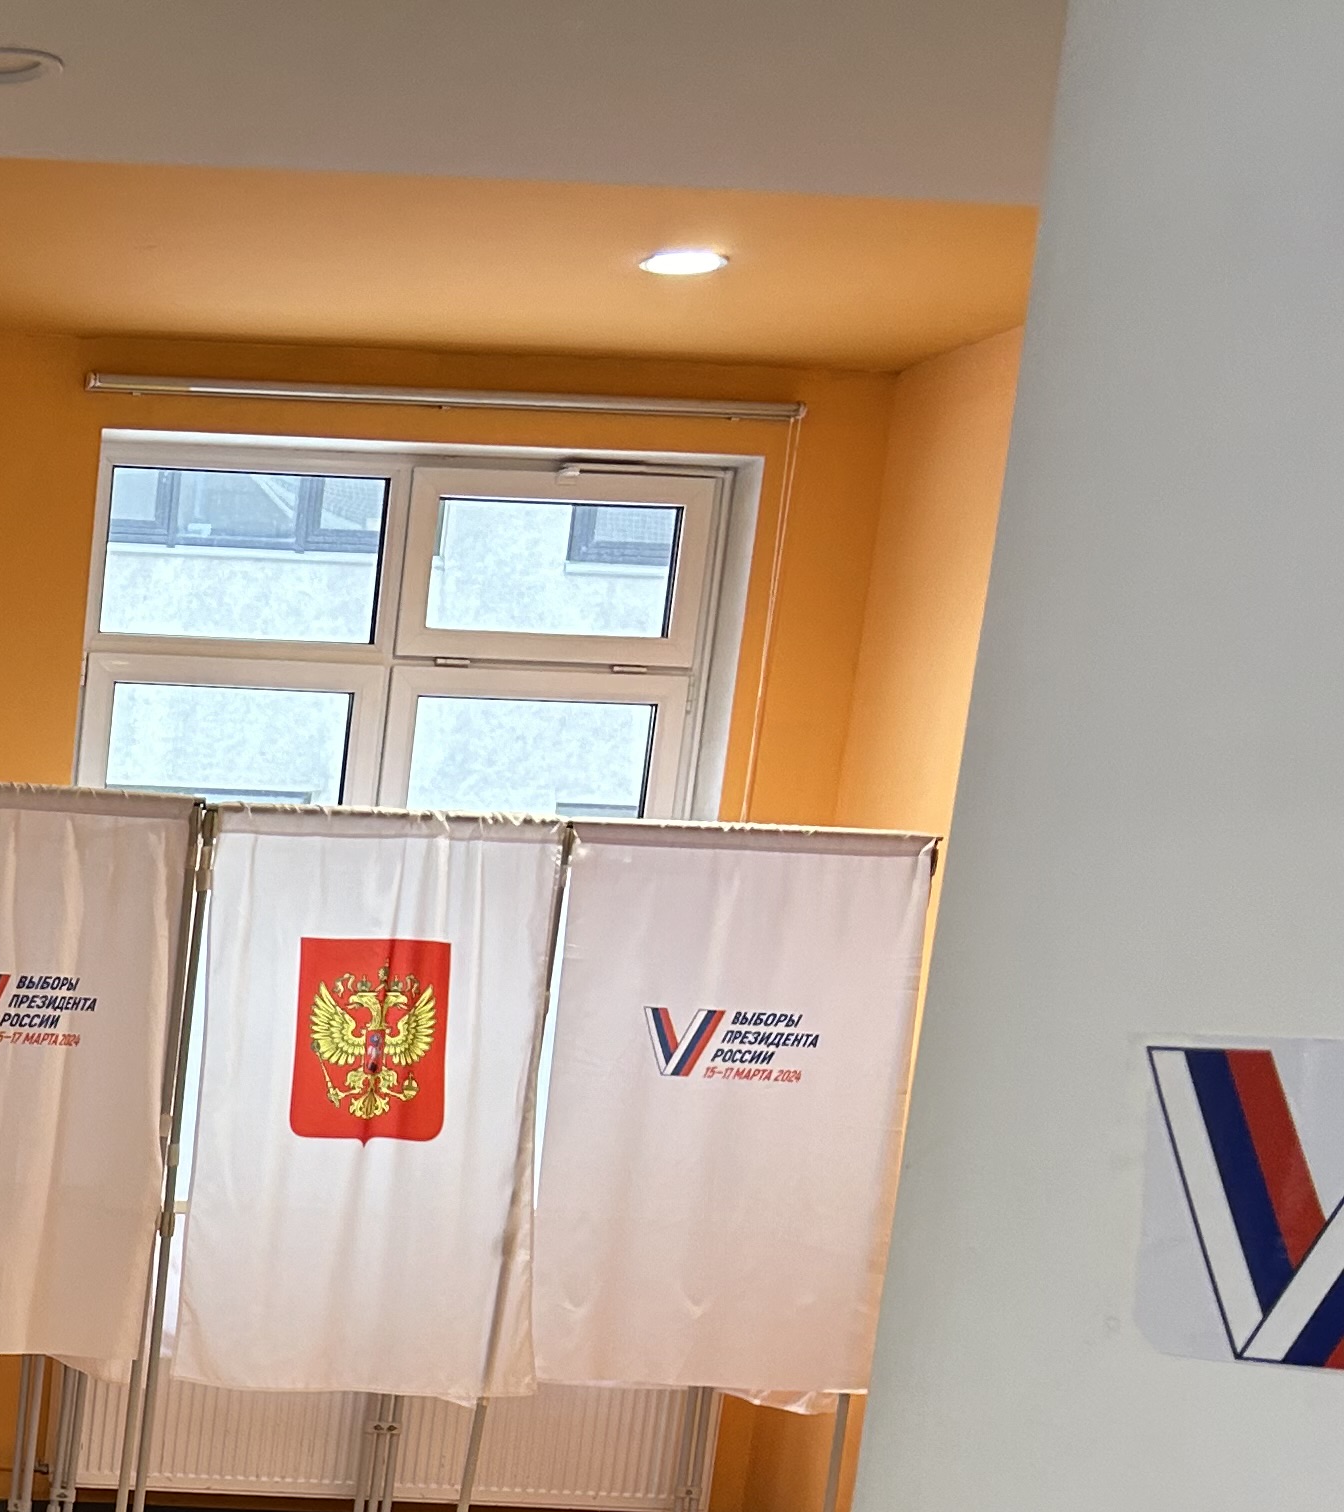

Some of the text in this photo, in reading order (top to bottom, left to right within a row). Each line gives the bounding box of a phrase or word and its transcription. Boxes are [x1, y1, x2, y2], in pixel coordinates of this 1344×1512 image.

[16, 975, 80, 991] ВЫБОРЫ
[8, 993, 98, 1012] ПРЕЗИДЕНТА
[0, 1012, 61, 1029] РОССИИ
[731, 1011, 803, 1028] ВЫБОРЫ
[22, 1032, 59, 1046] МАРТА
[59, 1033, 80, 1047] 2024
[720, 1029, 820, 1048] ПРЕЗИДЕНТА
[711, 1048, 776, 1065] РОССИИ
[732, 1067, 773, 1081] МАРТА
[773, 1069, 802, 1083] 2024
